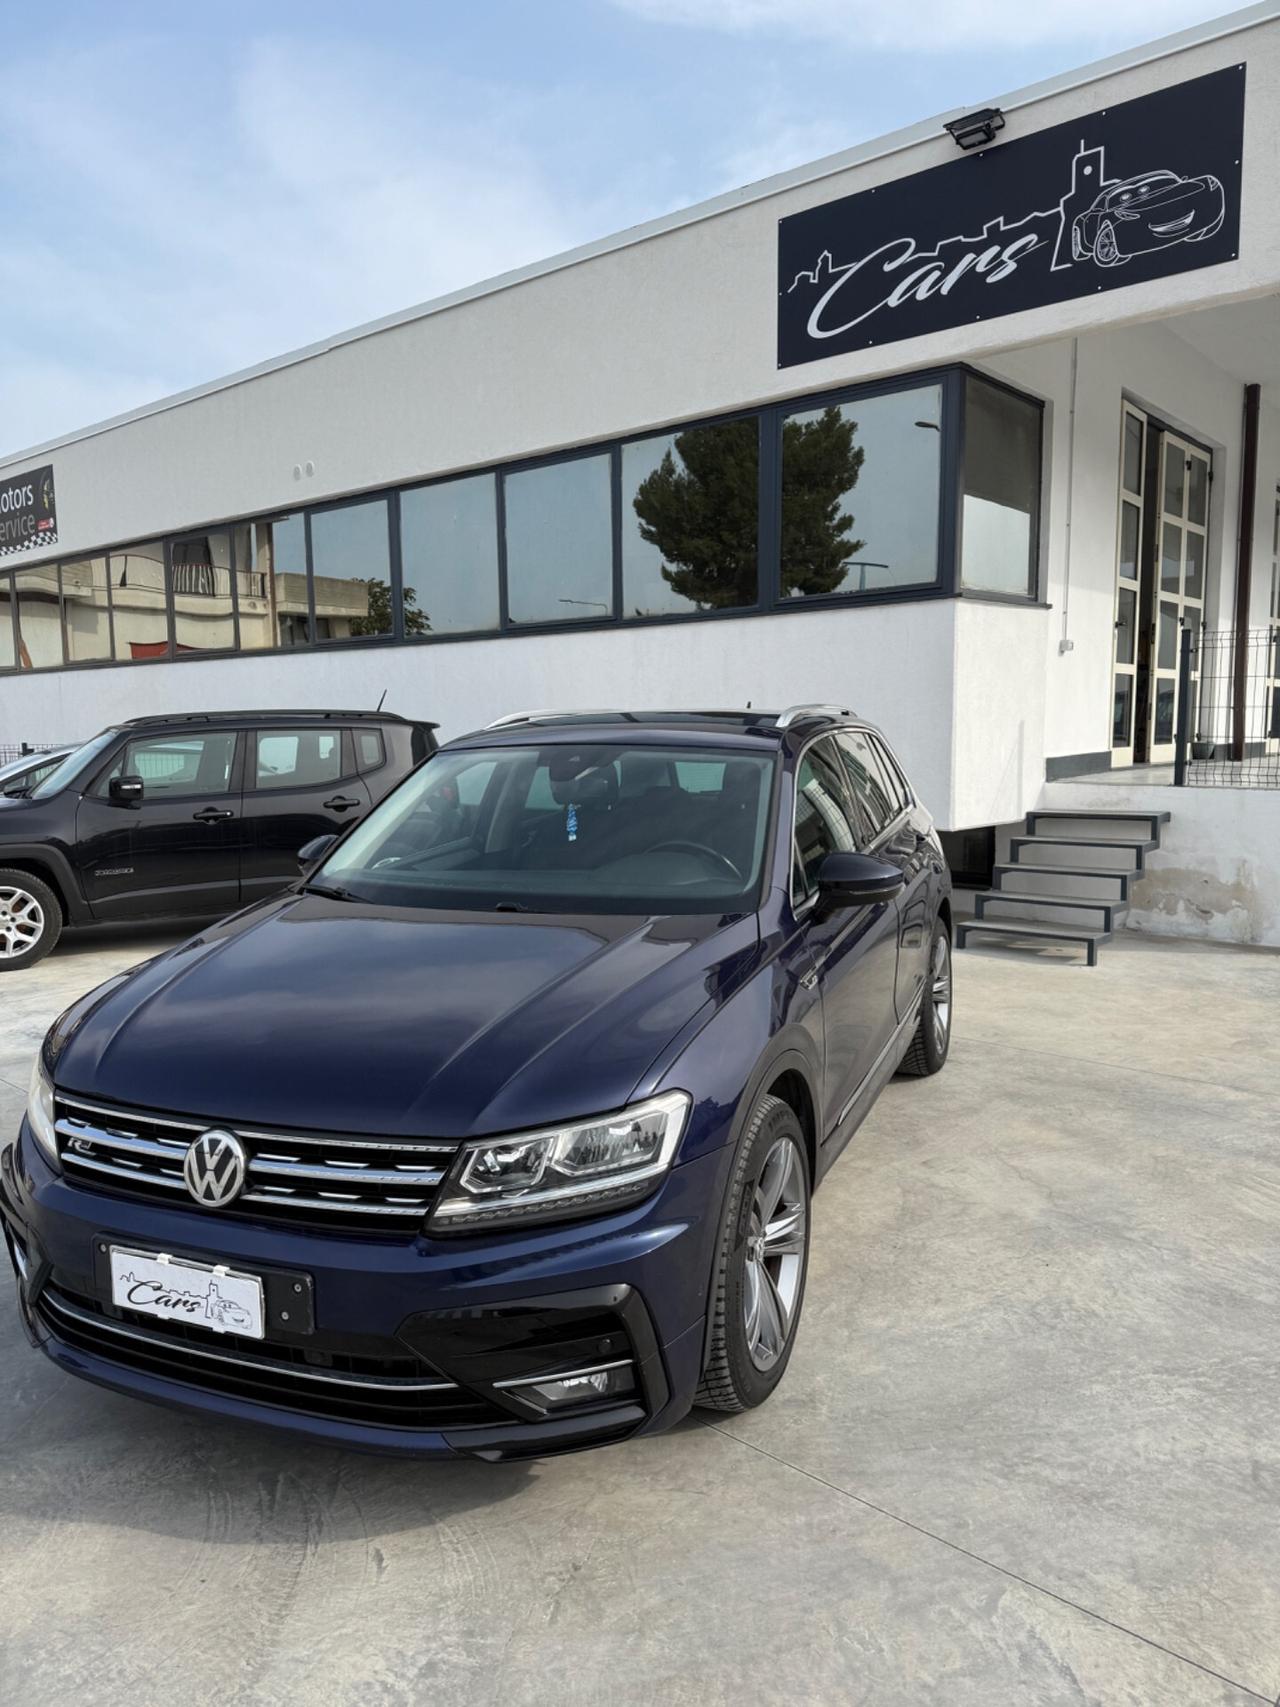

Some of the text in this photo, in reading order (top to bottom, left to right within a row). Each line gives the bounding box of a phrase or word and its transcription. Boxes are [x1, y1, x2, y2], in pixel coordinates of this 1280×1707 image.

[807, 233, 1047, 338] Cars
[0, 485, 33, 513] otors
[127, 1280, 203, 1313] Cars
